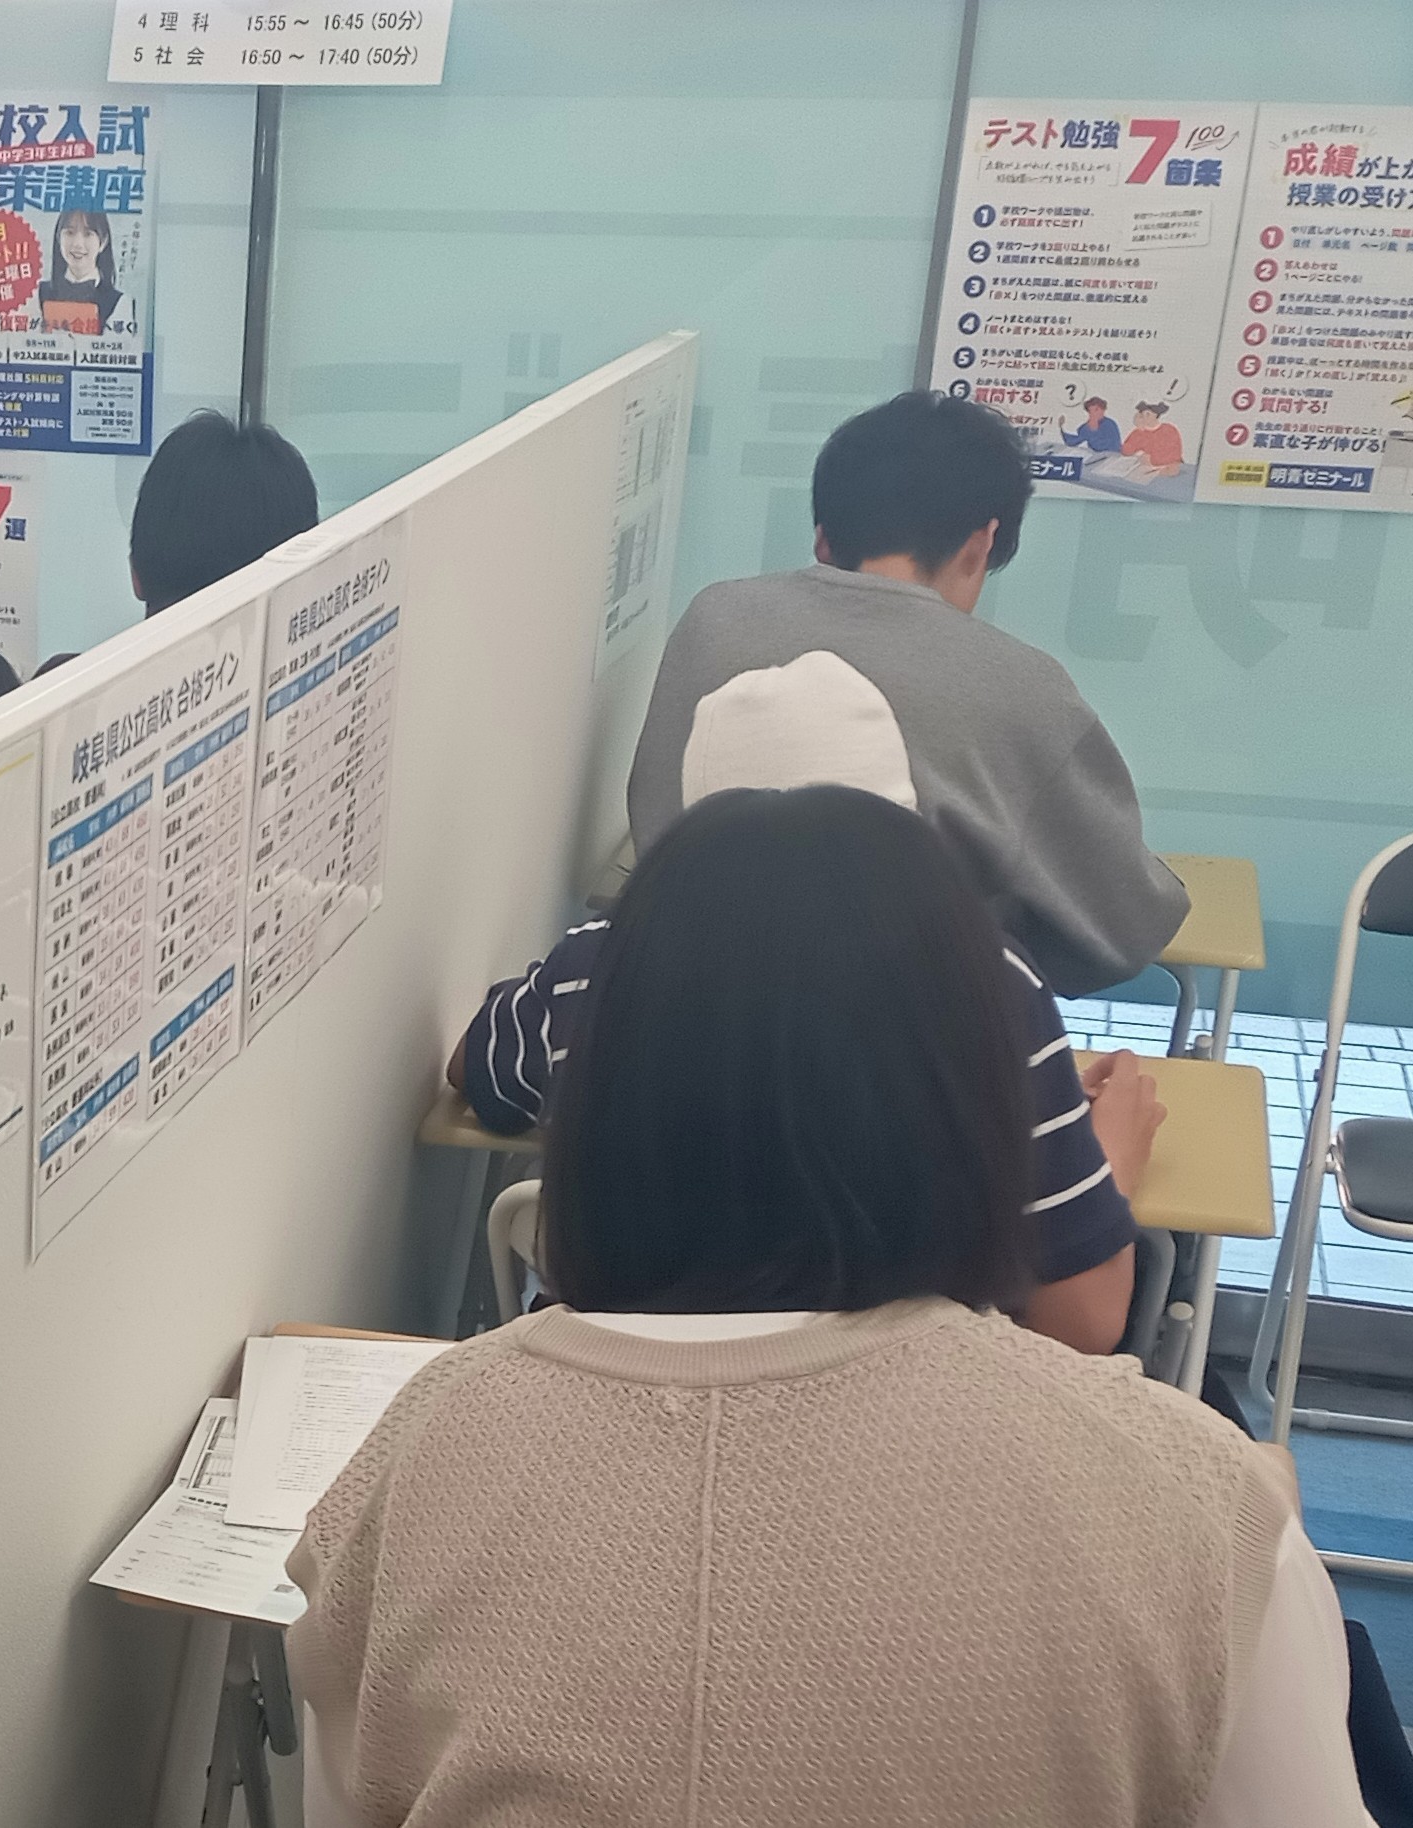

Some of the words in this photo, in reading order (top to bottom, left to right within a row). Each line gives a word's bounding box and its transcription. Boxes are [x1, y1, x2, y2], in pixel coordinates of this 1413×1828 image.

[138, 15, 148, 29] 4
[247, 15, 287, 32] 15:55
[323, 14, 365, 30] 16:45
[371, 11, 424, 31] (50分)
[133, 47, 144, 63] 5
[241, 50, 282, 65] 16:50
[319, 50, 360, 65] 17:40
[367, 47, 419, 66] (50分)
[984, 118, 1121, 149] テスト勉強
[1124, 119, 1181, 184] 7
[974, 387, 1040, 405] 質問する!
[1259, 397, 1328, 414] 質問する!
[1252, 433, 1388, 454] 素直な子が伸びる!
[1270, 467, 1365, 488] 明青ゼミナール
[351, 557, 391, 606] 合格ライン
[72, 690, 175, 785] 岐阜県公立高校
[176, 650, 240, 720] 合格ライン
